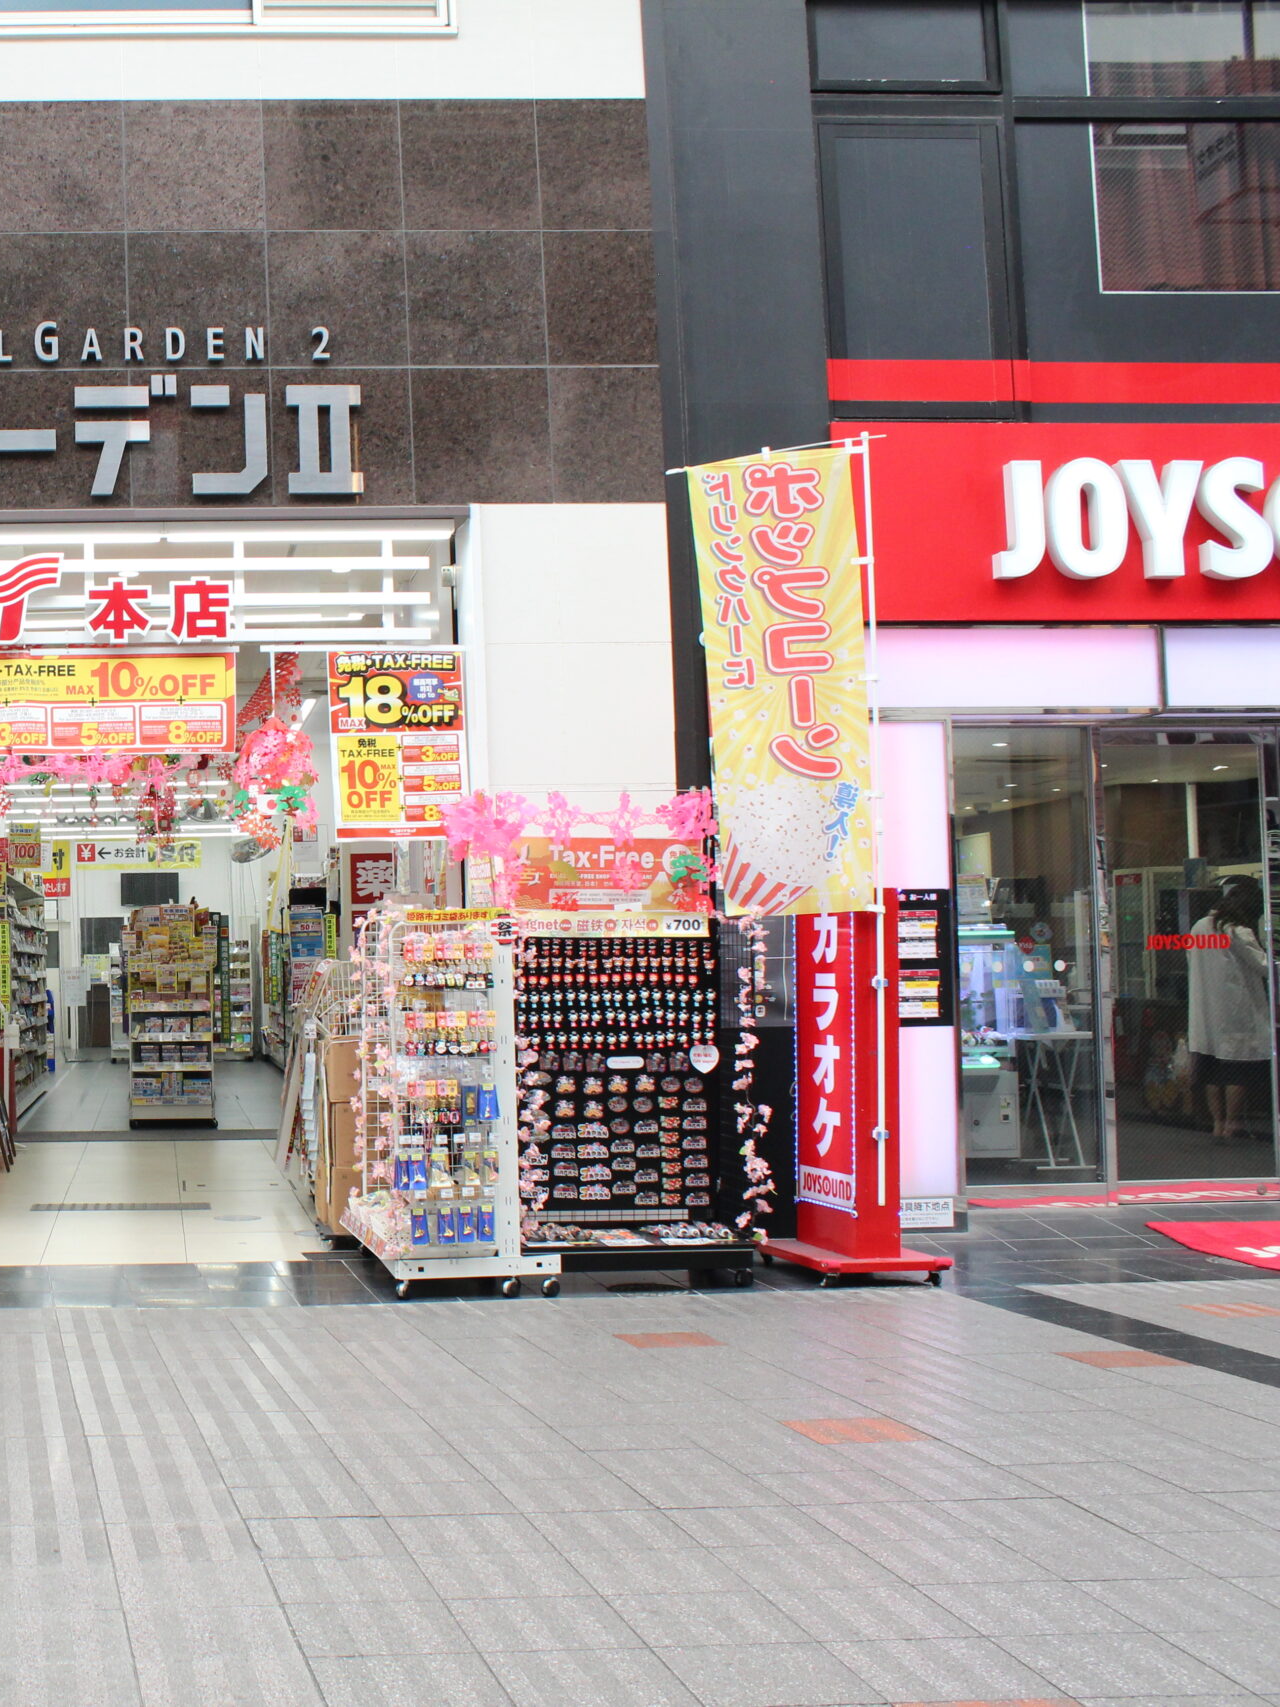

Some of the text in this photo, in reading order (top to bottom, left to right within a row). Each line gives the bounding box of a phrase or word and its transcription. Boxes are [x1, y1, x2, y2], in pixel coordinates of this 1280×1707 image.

[311, 326, 332, 363] 2
[992, 456, 1280, 580] JOYS
[86, 578, 233, 642] 本店
[65, 661, 215, 697] MAX 10%OFF
[338, 675, 456, 725] 18%OFF
[169, 721, 222, 744] 8%OFF
[340, 718, 365, 728] MAX
[80, 722, 135, 746] 5%OFF
[358, 738, 377, 748] 免税
[341, 749, 395, 758] TAX-FREE
[421, 746, 459, 762] 3%OFF
[423, 775, 460, 791] 5%OFF
[347, 791, 393, 809] OFF
[114, 847, 146, 859] お会計
[356, 859, 393, 897] 薬
[406, 910, 489, 922] 姫路市ゴミ袋あります
[666, 919, 702, 931] ¥700
[1146, 934, 1231, 950] JOYSOUND
[811, 910, 841, 1158] カラオケ
[802, 1172, 853, 1202] JOYSOUND
